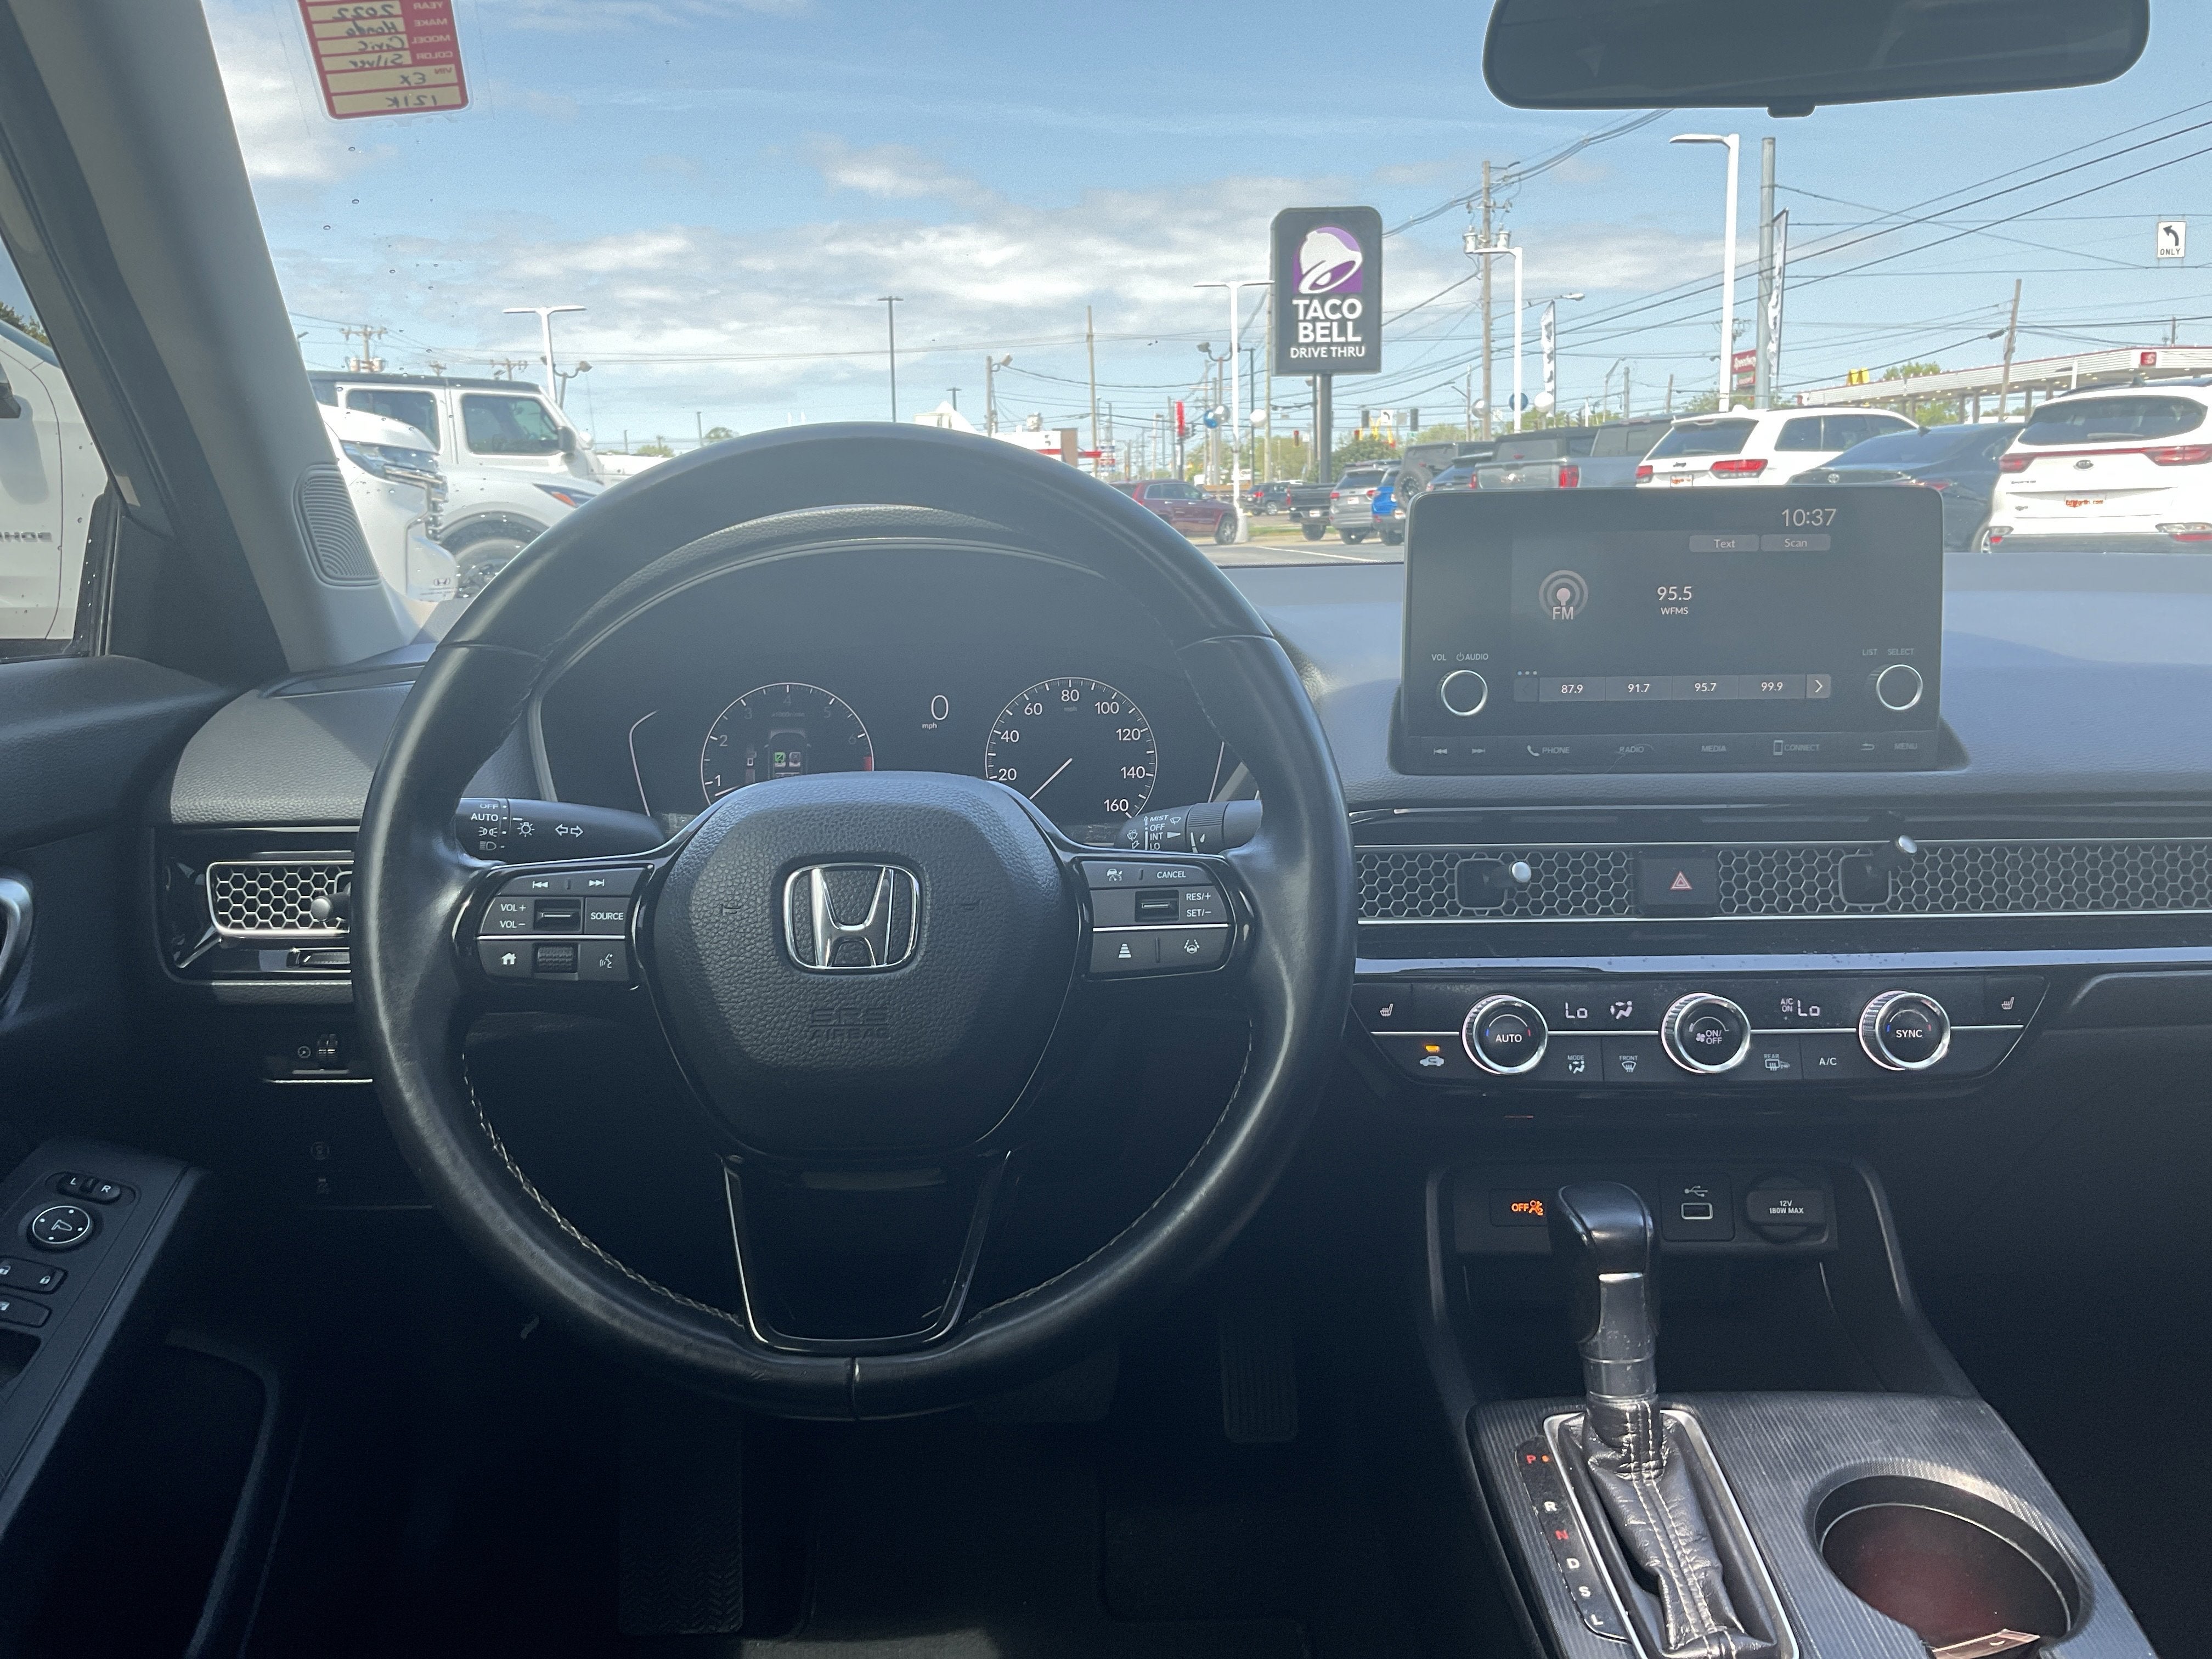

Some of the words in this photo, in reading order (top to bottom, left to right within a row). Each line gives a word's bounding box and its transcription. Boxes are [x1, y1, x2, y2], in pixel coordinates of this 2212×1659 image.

[1292, 298, 1363, 320] TACO
[1298, 321, 1362, 343] BELL
[1290, 347, 1328, 358] DRIVE
[1330, 346, 1364, 357] THRU
[1781, 508, 1837, 527] 10:37
[1714, 539, 1735, 548] Text
[1785, 539, 1807, 547] Scan
[1657, 586, 1692, 601] 95.5
[1553, 606, 1573, 619] FM
[1561, 685, 1582, 693] 87.9
[1628, 684, 1649, 692] 91.7
[1694, 683, 1716, 691] 95.7
[1761, 682, 1782, 690] 99.9
[1061, 689, 1079, 702] 80
[931, 695, 949, 720] 0
[1024, 703, 1042, 715] 60
[1095, 702, 1119, 714] 100
[719, 735, 727, 746] 2
[1001, 730, 1019, 742] 40
[1116, 729, 1141, 741] 120
[998, 768, 1017, 781] 20
[1120, 766, 1145, 778] 140
[715, 775, 720, 786] 1
[1104, 799, 1128, 811] 160
[590, 912, 623, 920] SOURCE
[1565, 1002, 1588, 1019] Lo
[1797, 1000, 1820, 1017] Lo
[1495, 1034, 1522, 1042] AUTO
[1895, 1029, 1922, 1038] SYNC
[1819, 1057, 1836, 1065] A/C
[1511, 1203, 1528, 1211] OFF
[1526, 1454, 1536, 1463] P
[1544, 1502, 1557, 1511] R
[1555, 1530, 1568, 1539] N
[1566, 1558, 1579, 1568] D
[1579, 1586, 1591, 1596] S
[1592, 1614, 1603, 1625] L
